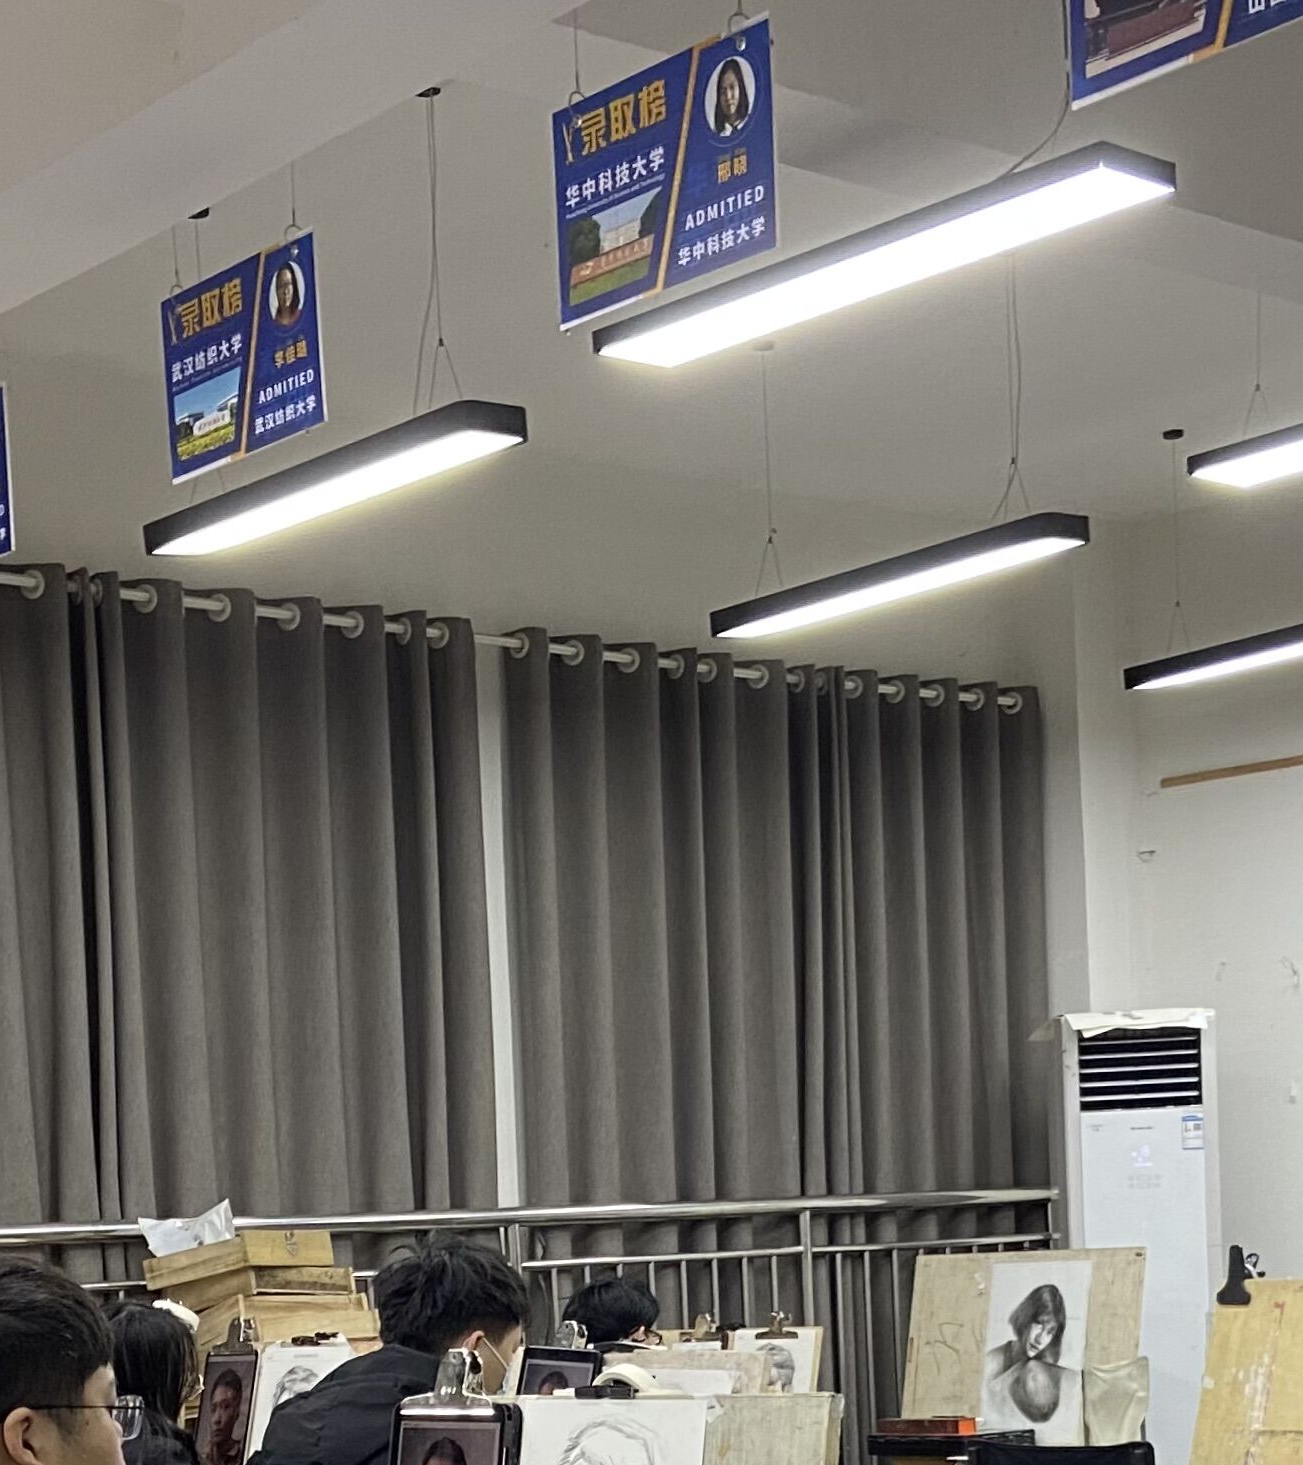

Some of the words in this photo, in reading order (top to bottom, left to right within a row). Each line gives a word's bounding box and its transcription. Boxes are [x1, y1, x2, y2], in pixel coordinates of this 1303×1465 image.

[581, 80, 666, 156] 录取榜
[565, 146, 665, 208] 华中科技大学
[685, 185, 765, 231] ADMITIED
[678, 216, 766, 266] 华中科技大学
[179, 277, 243, 338] 录取榜
[172, 334, 242, 383] 武汉纺织大学
[258, 369, 315, 404] ADMITIED
[255, 394, 317, 435] 武汉纺织大学
